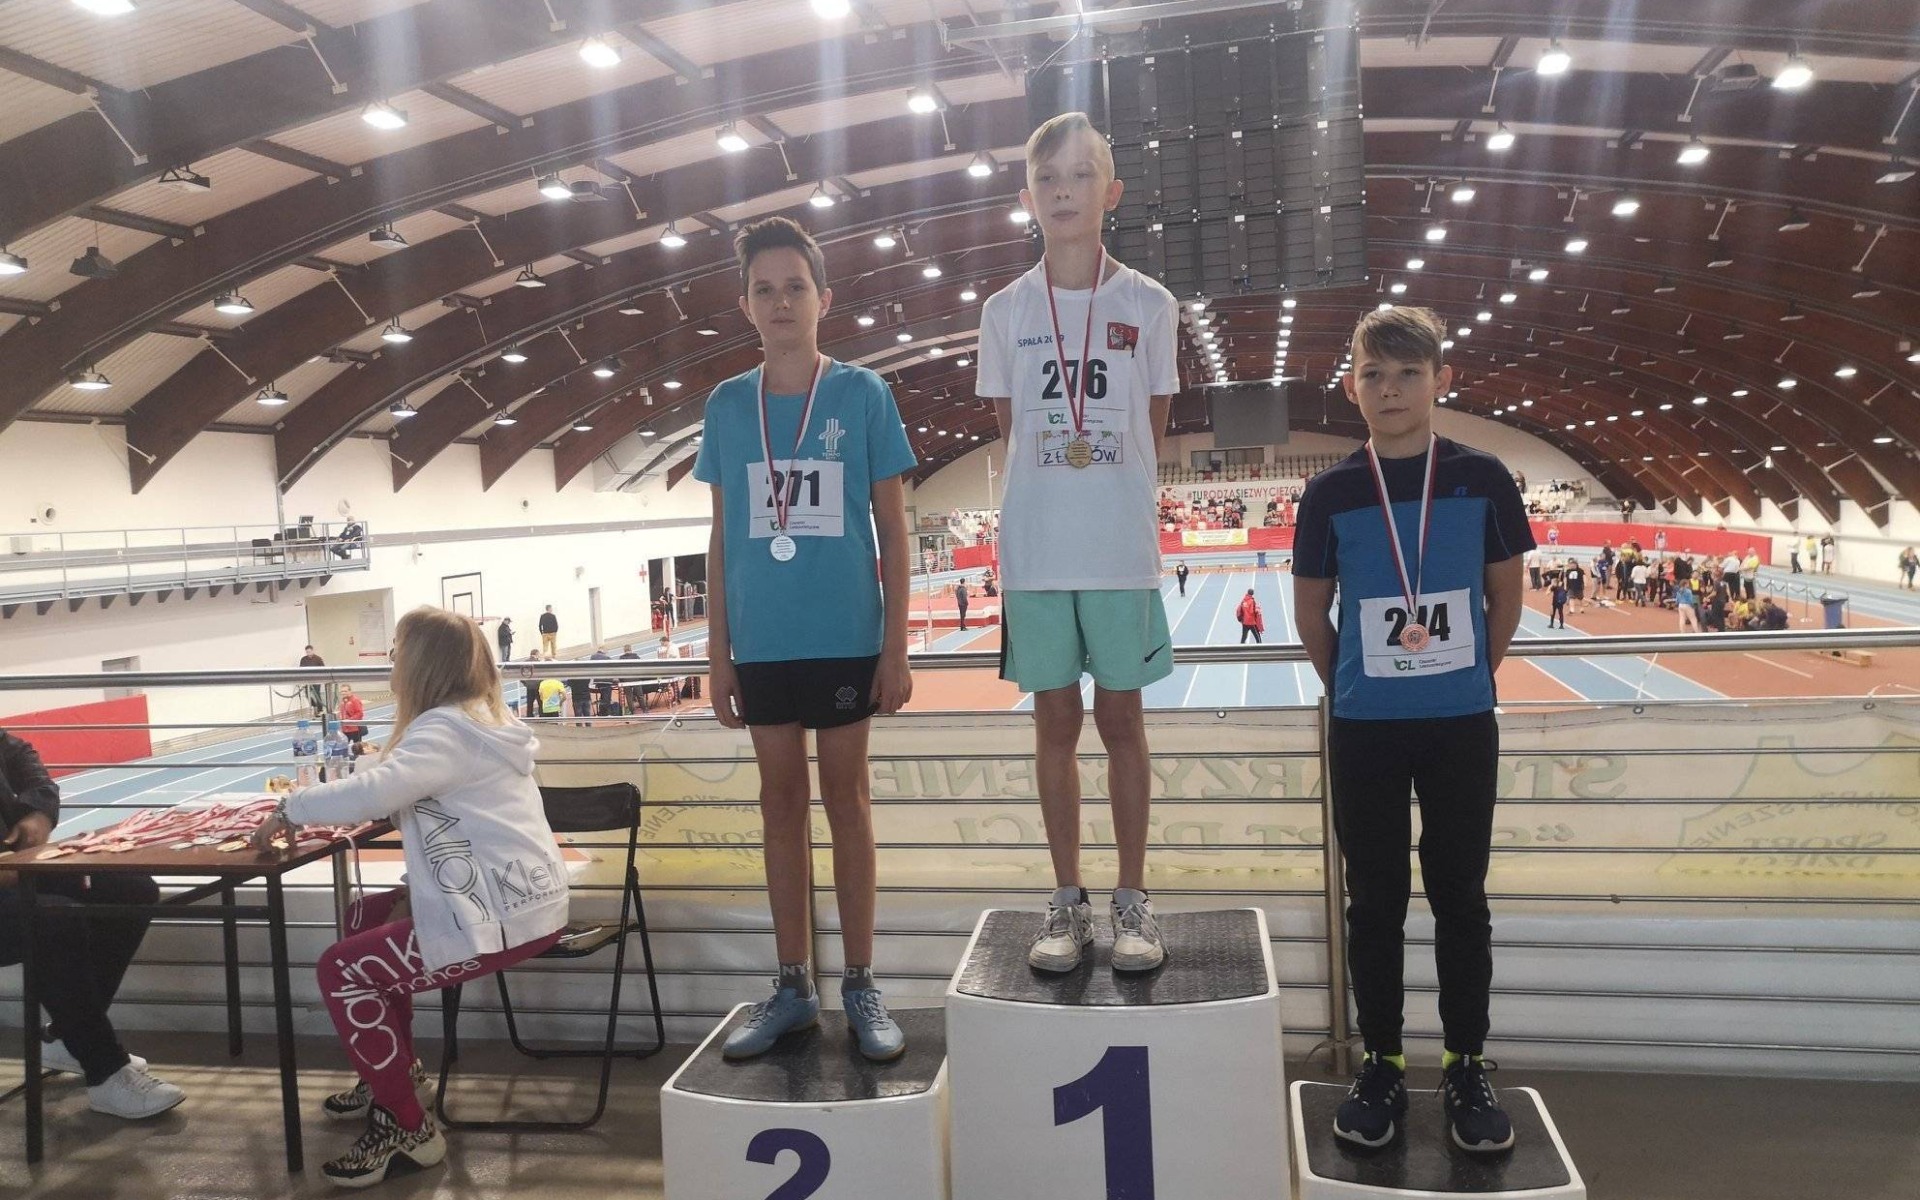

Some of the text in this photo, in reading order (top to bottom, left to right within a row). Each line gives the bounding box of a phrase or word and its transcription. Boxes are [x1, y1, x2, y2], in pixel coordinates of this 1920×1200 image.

[1018, 336, 1042, 347] SPAŁA
[1042, 358, 1107, 399] 276
[1043, 445, 1117, 464] ZŁÓW
[766, 470, 820, 507] 271
[1053, 1045, 1155, 1200] 1
[745, 1127, 831, 1200] 2
